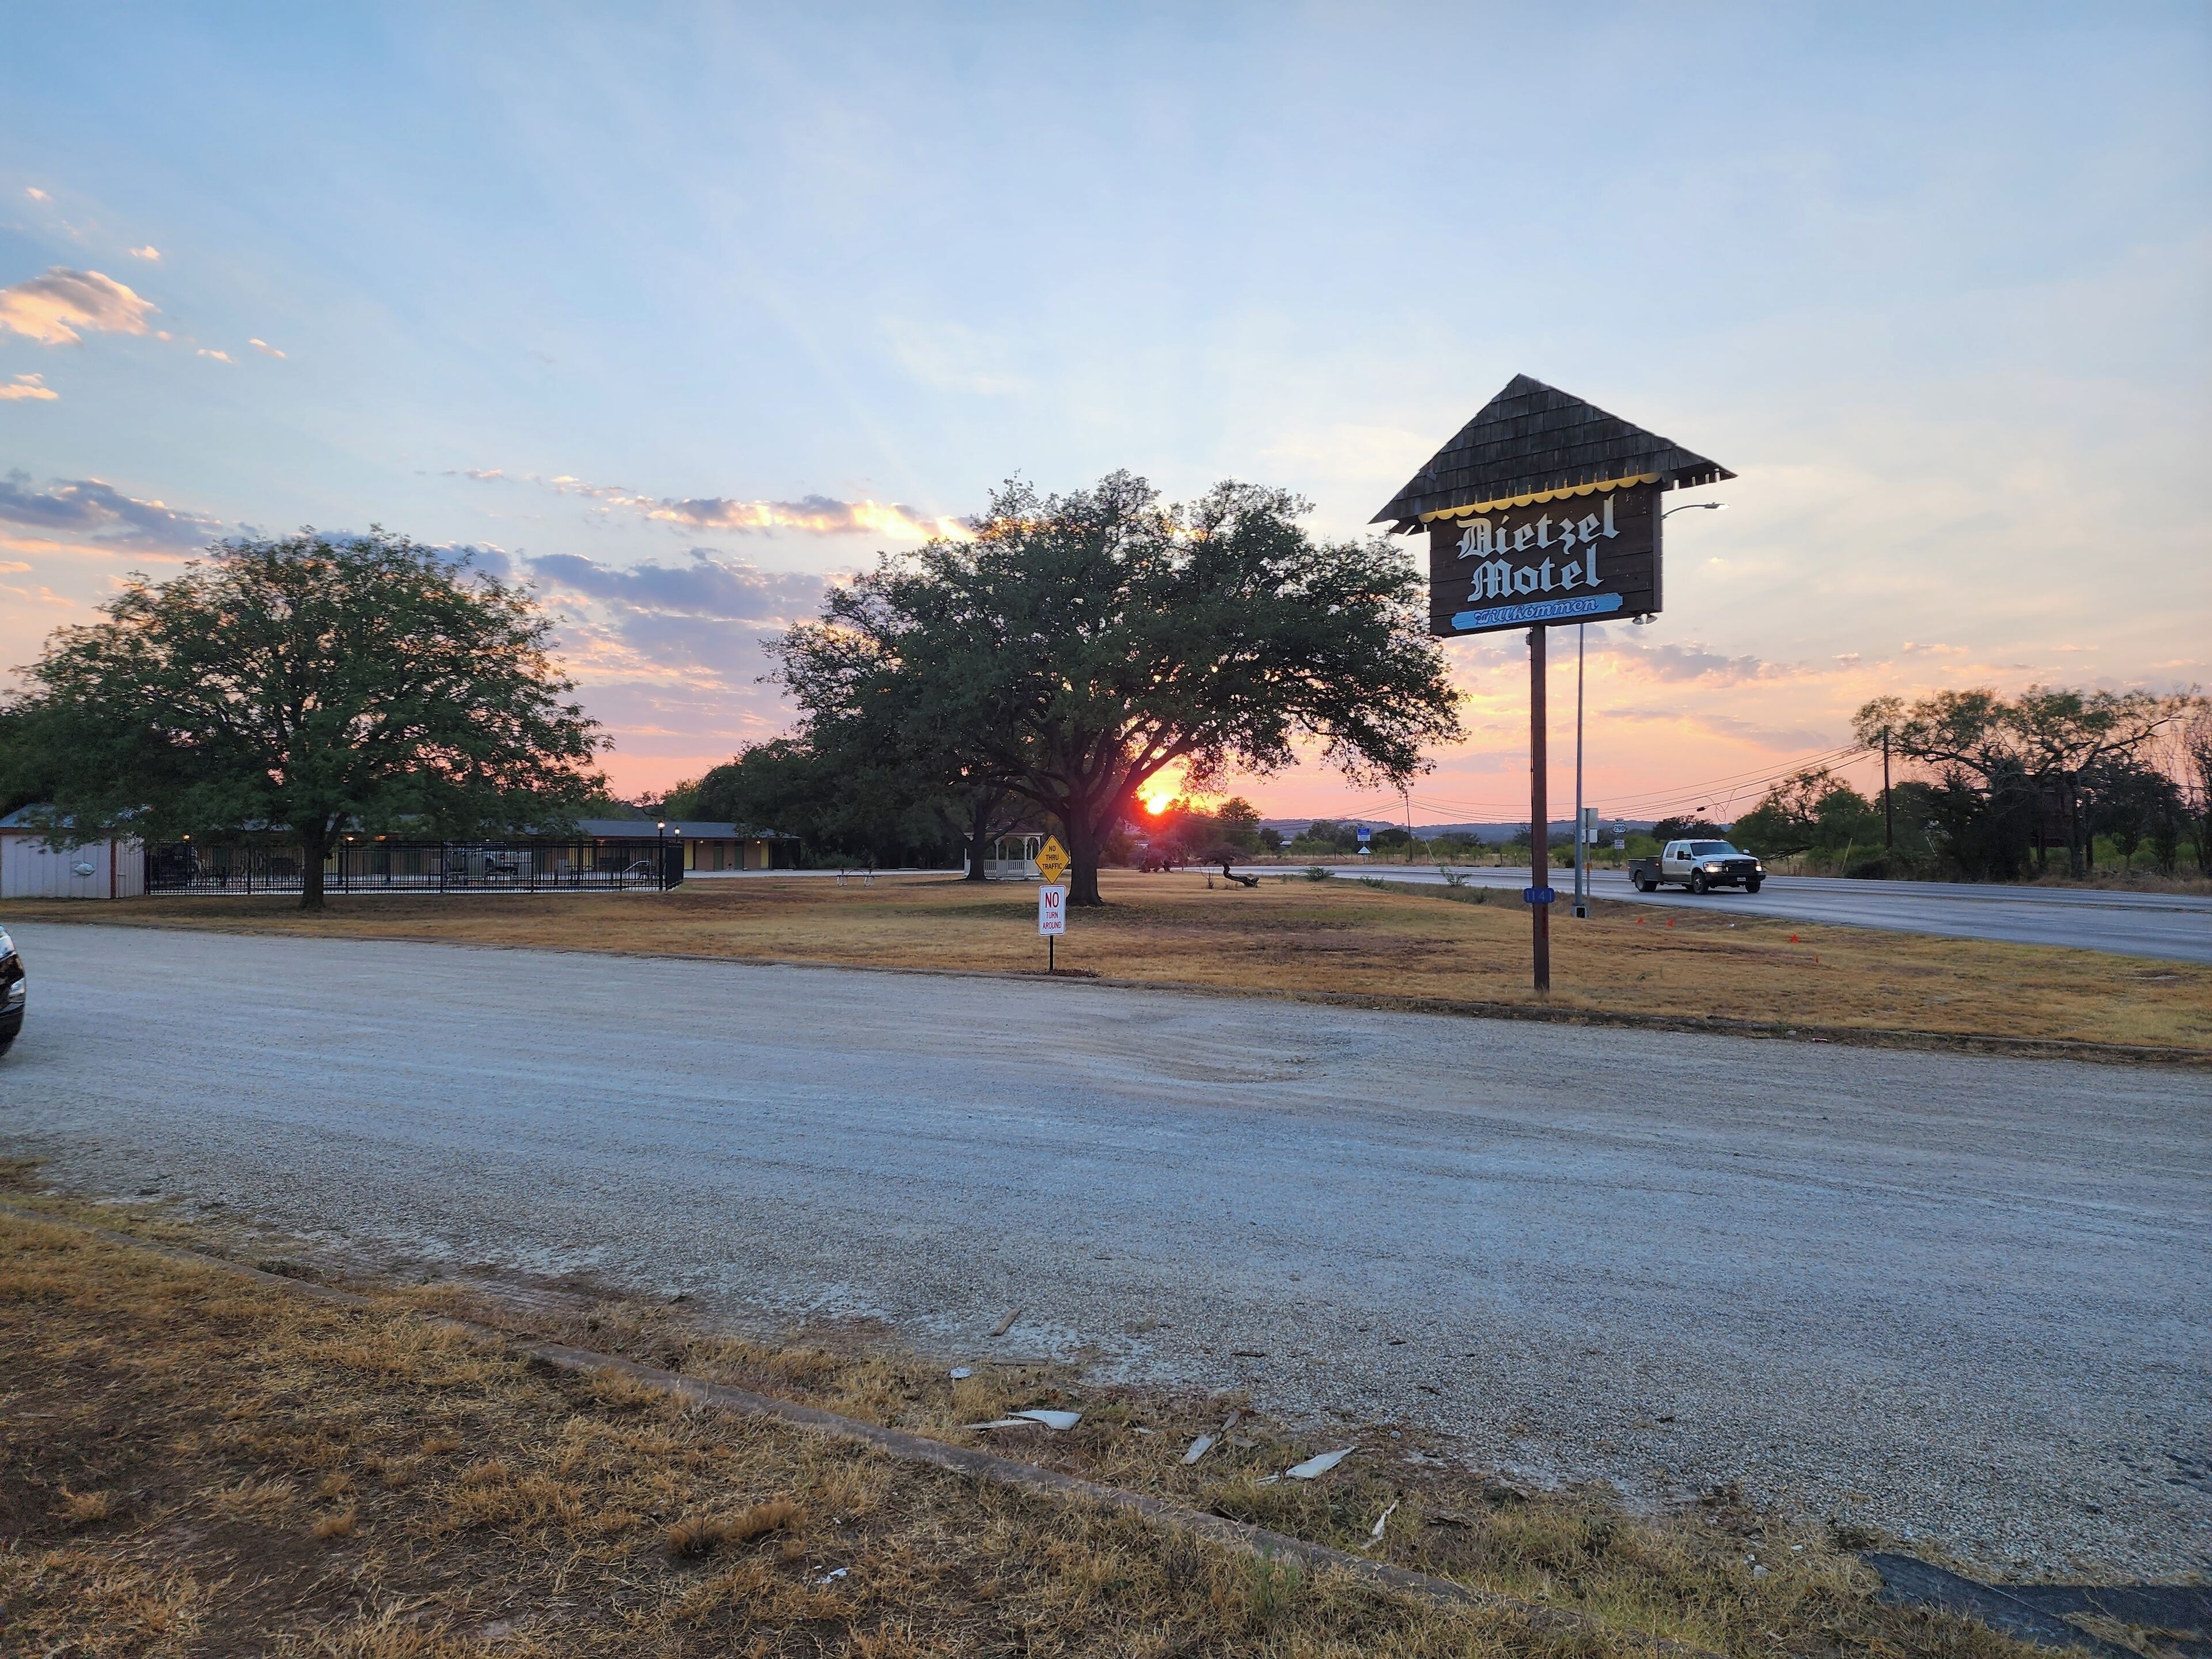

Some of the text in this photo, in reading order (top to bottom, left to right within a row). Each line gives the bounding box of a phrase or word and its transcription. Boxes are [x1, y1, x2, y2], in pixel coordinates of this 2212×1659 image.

[1456, 494, 1620, 560] Dietzel
[1467, 543, 1604, 602] Motel
[1474, 599, 1599, 625] Willkommen
[1045, 892, 1059, 908] NO
[1527, 891, 1551, 901] 1141
[1043, 922, 1062, 930] AROUND
